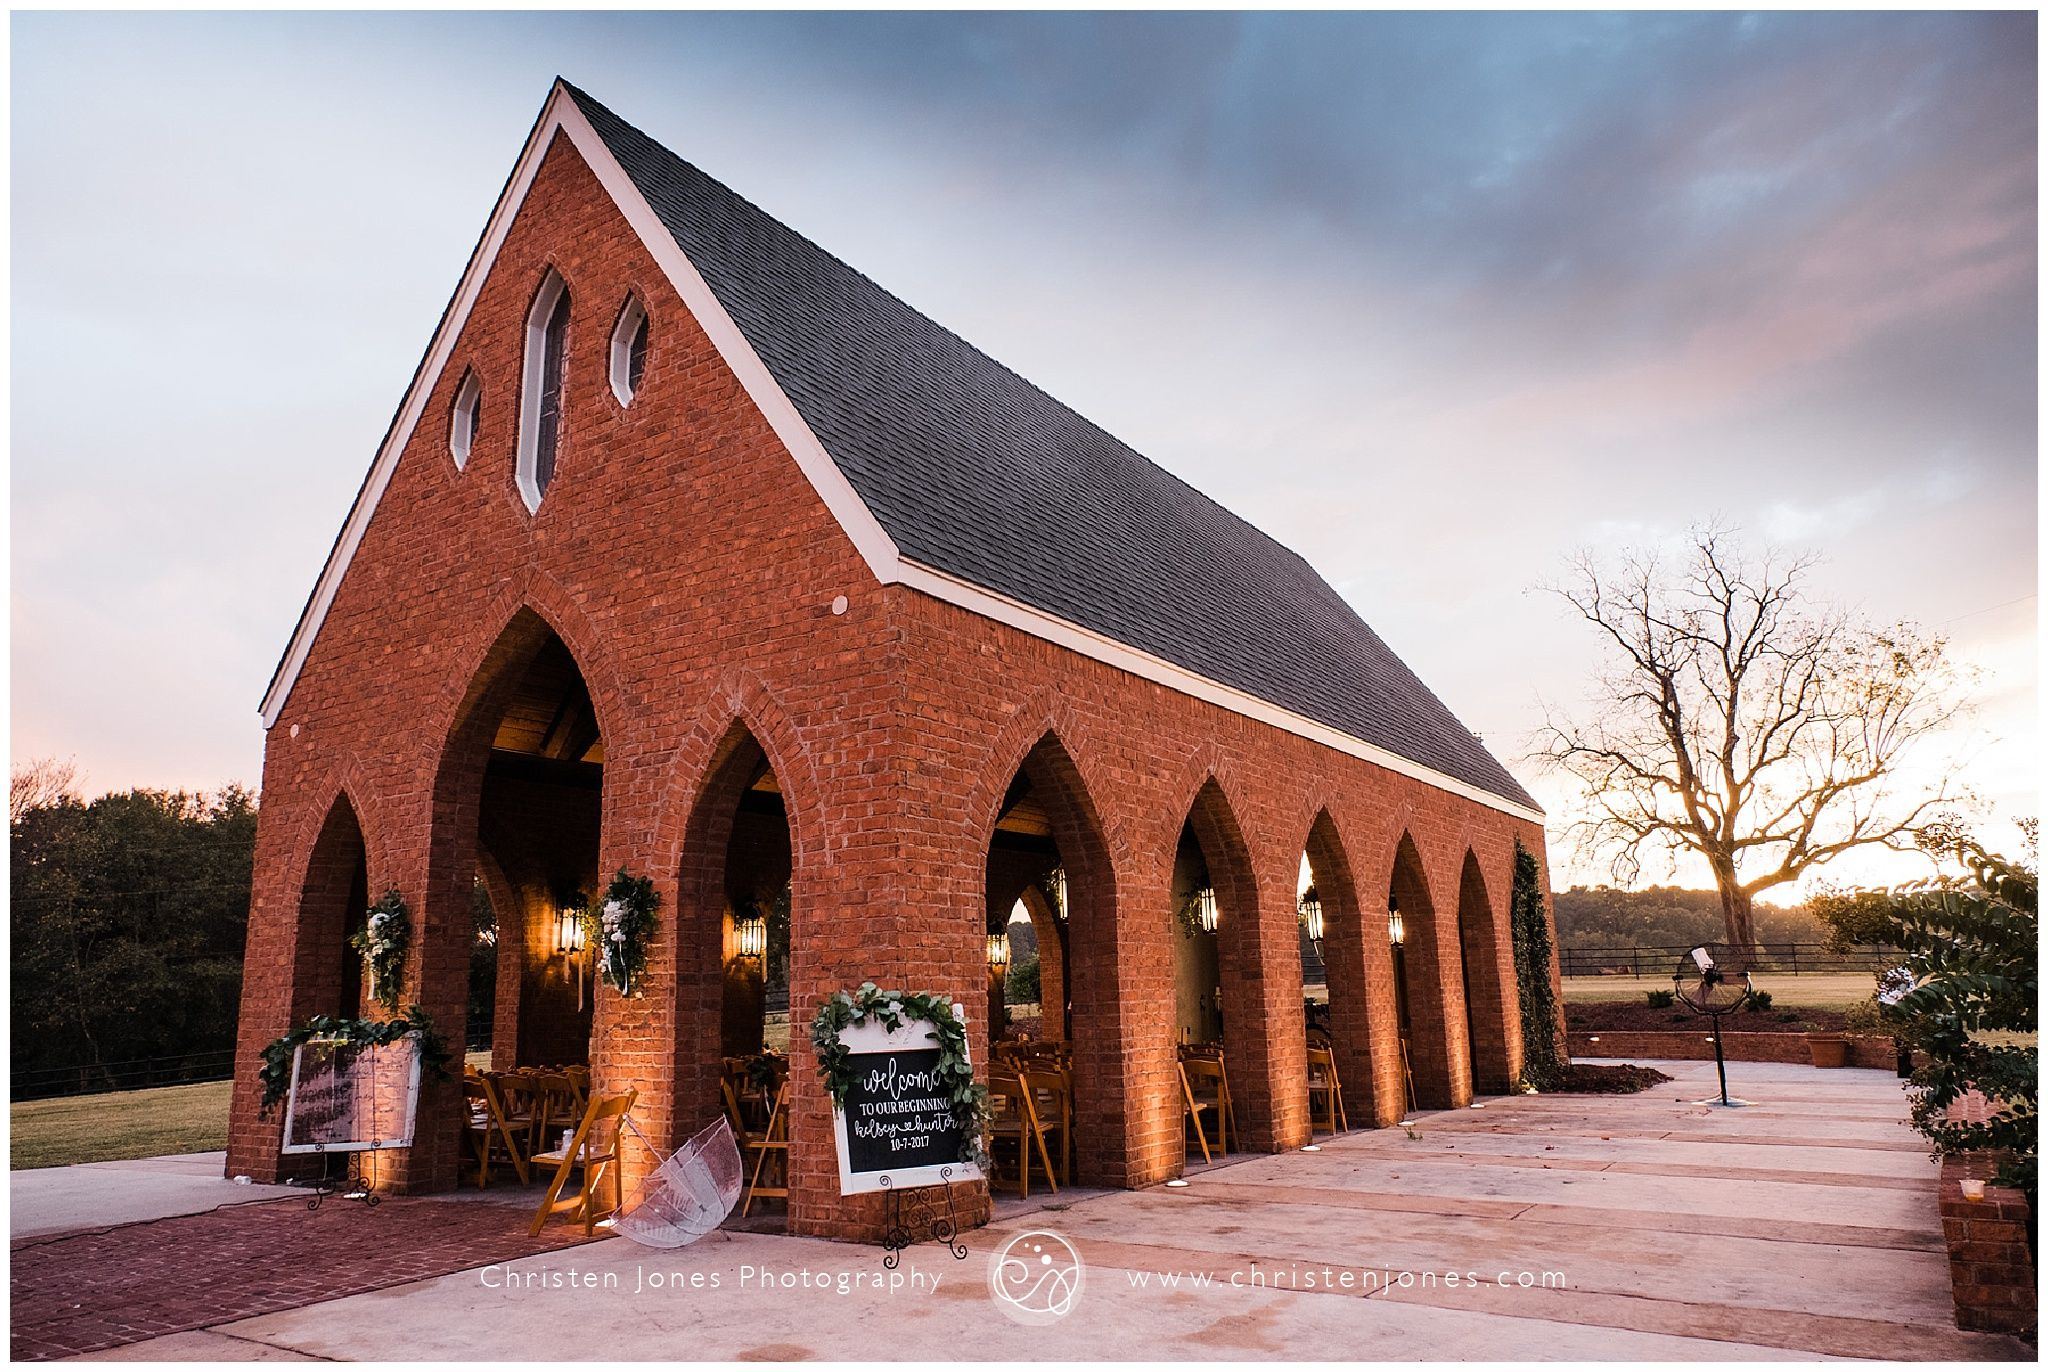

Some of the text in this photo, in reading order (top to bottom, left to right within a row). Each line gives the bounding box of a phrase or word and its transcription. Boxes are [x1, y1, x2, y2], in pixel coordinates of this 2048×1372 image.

[864, 1057, 941, 1100] welcome
[860, 1099, 950, 1116] TO OUR BEGINNING
[854, 1112, 958, 1138] kelsey hunter
[890, 1135, 930, 1151] 10-7-2017
